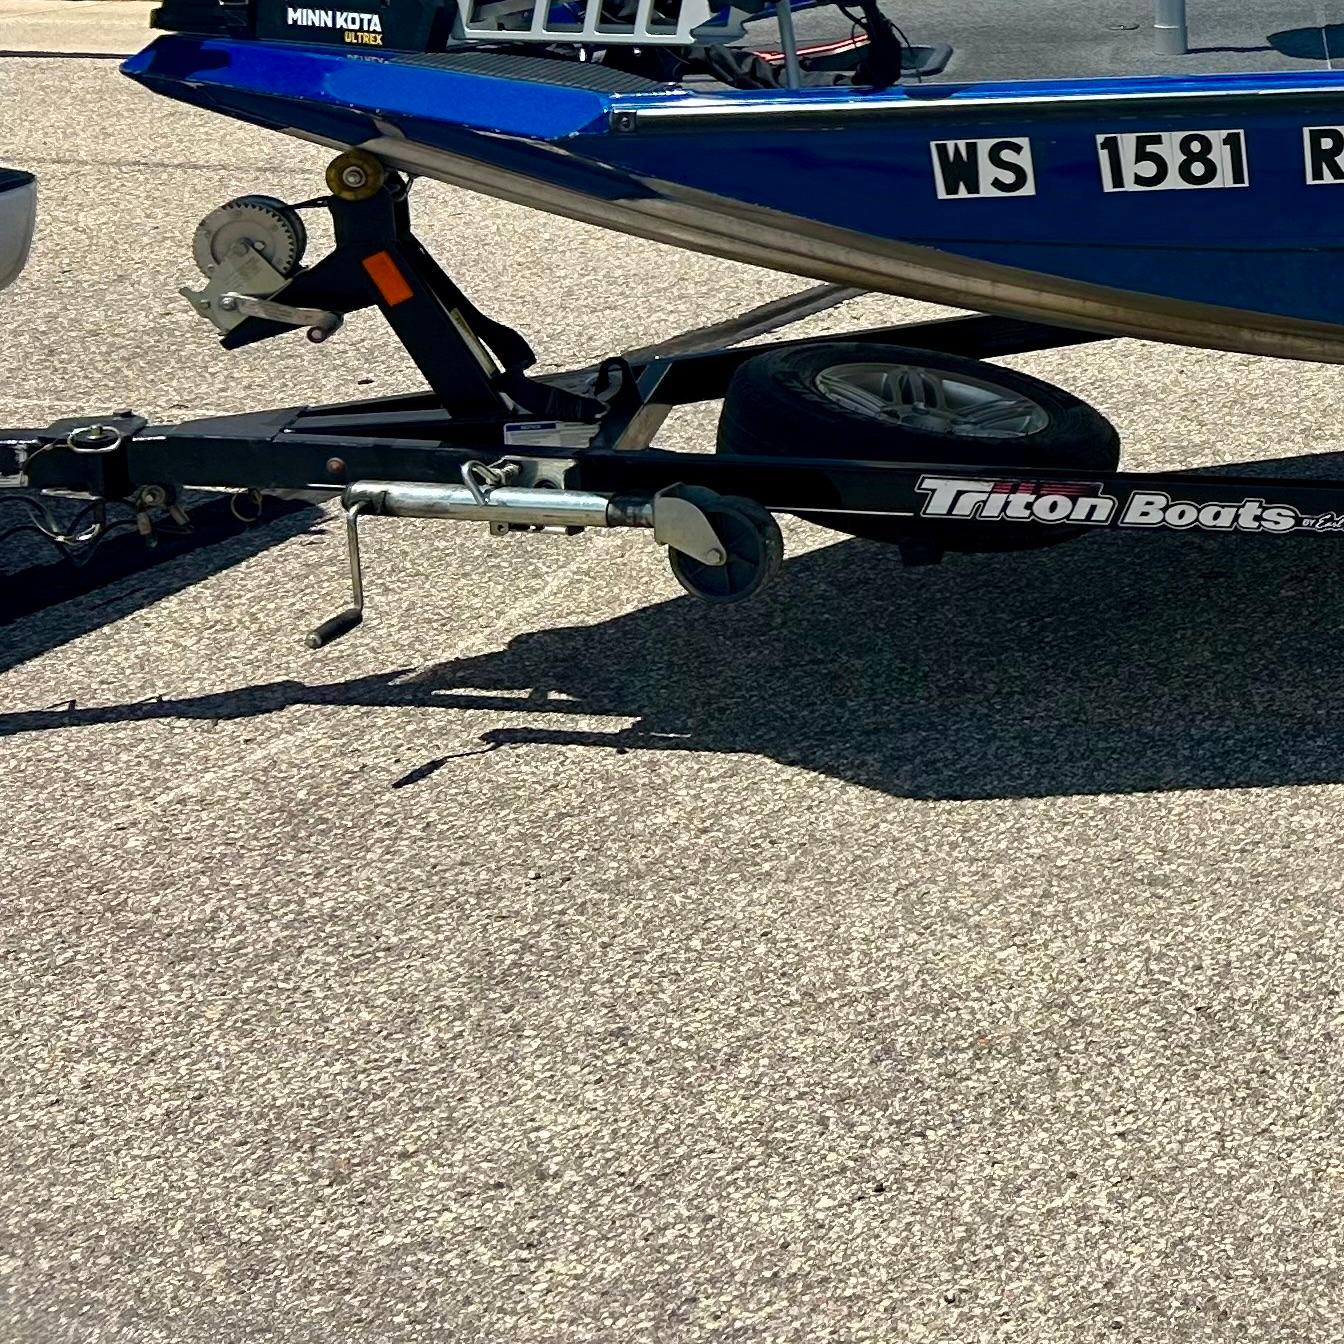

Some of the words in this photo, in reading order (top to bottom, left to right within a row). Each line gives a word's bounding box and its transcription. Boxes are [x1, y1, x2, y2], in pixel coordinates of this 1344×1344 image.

[287, 7, 333, 28] MINN
[336, 11, 383, 32] KOTA
[344, 31, 384, 46] ULTREX
[935, 140, 1029, 196] WS
[1100, 131, 1246, 190] 1581
[916, 475, 1115, 524] Triton
[1122, 492, 1297, 531] Boats
